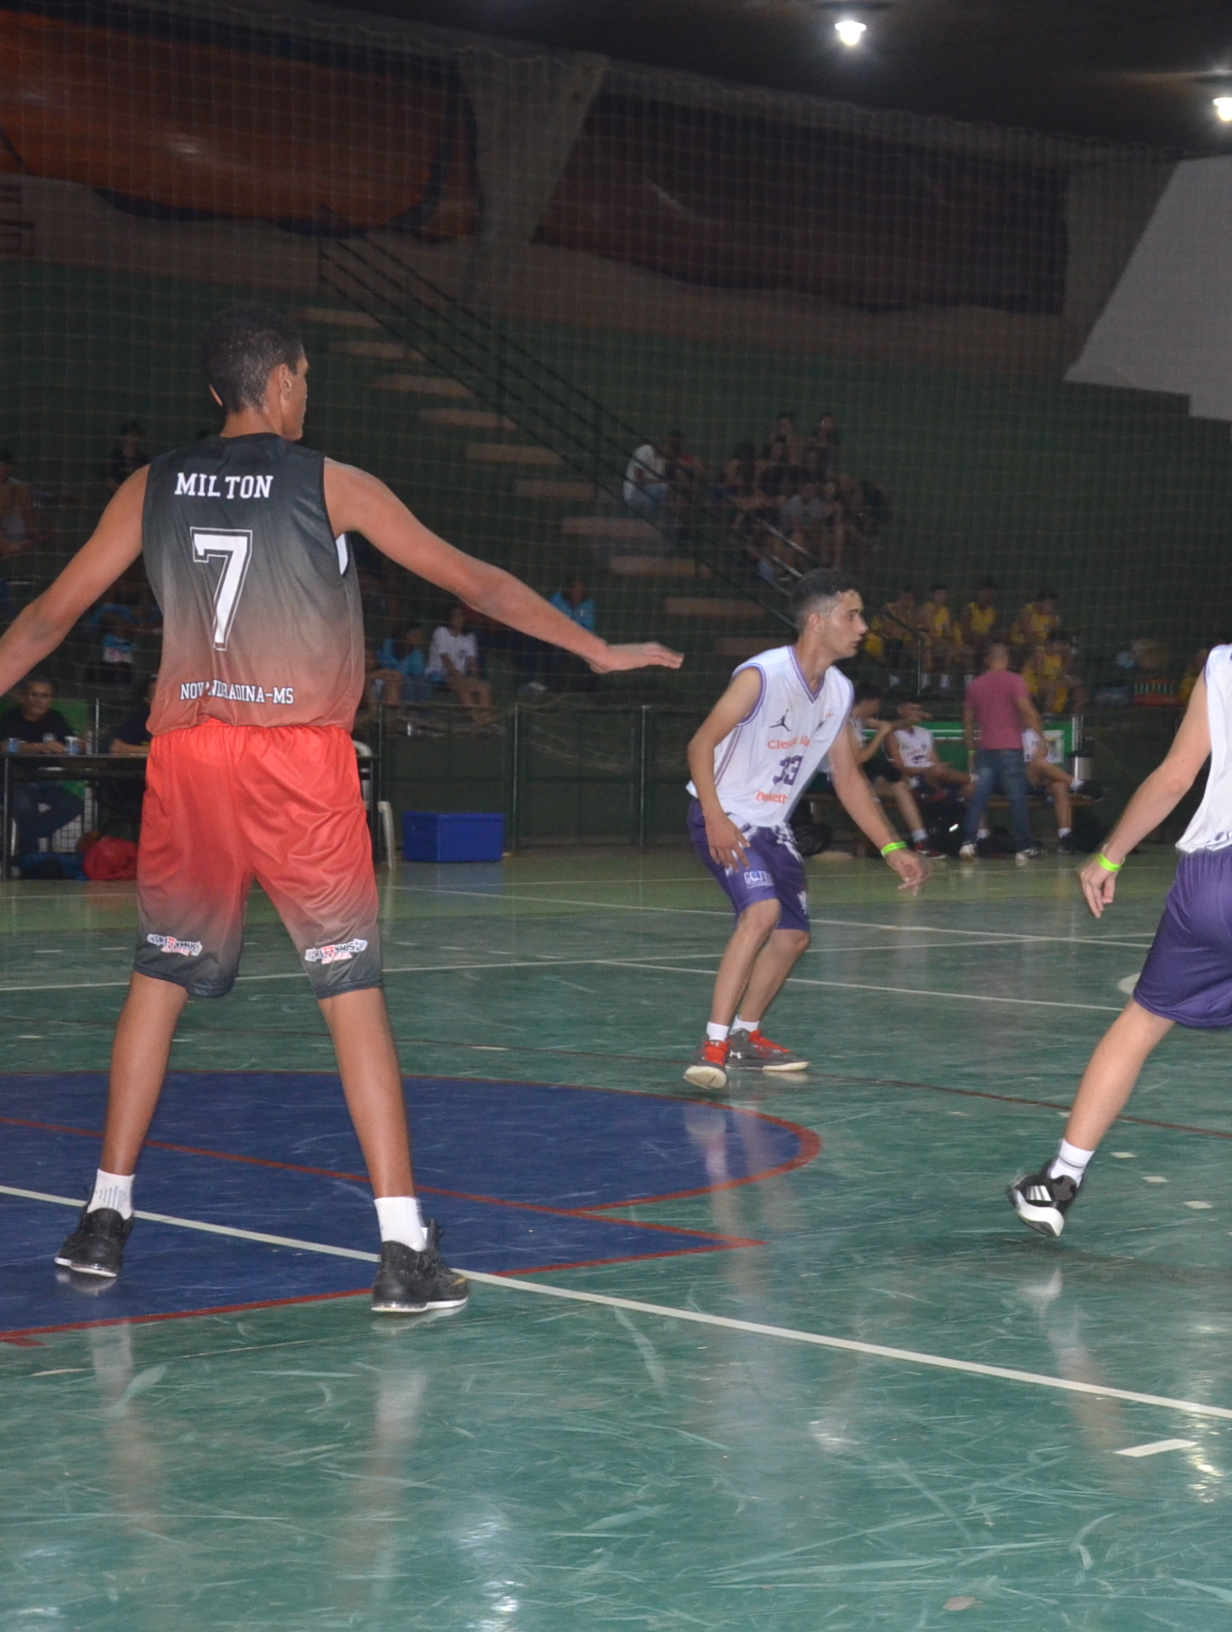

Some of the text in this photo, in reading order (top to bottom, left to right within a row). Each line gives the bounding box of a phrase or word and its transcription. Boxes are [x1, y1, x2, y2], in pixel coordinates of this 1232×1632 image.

[174, 472, 274, 499] MILTON
[189, 526, 253, 651] 7
[772, 755, 804, 786] 33
